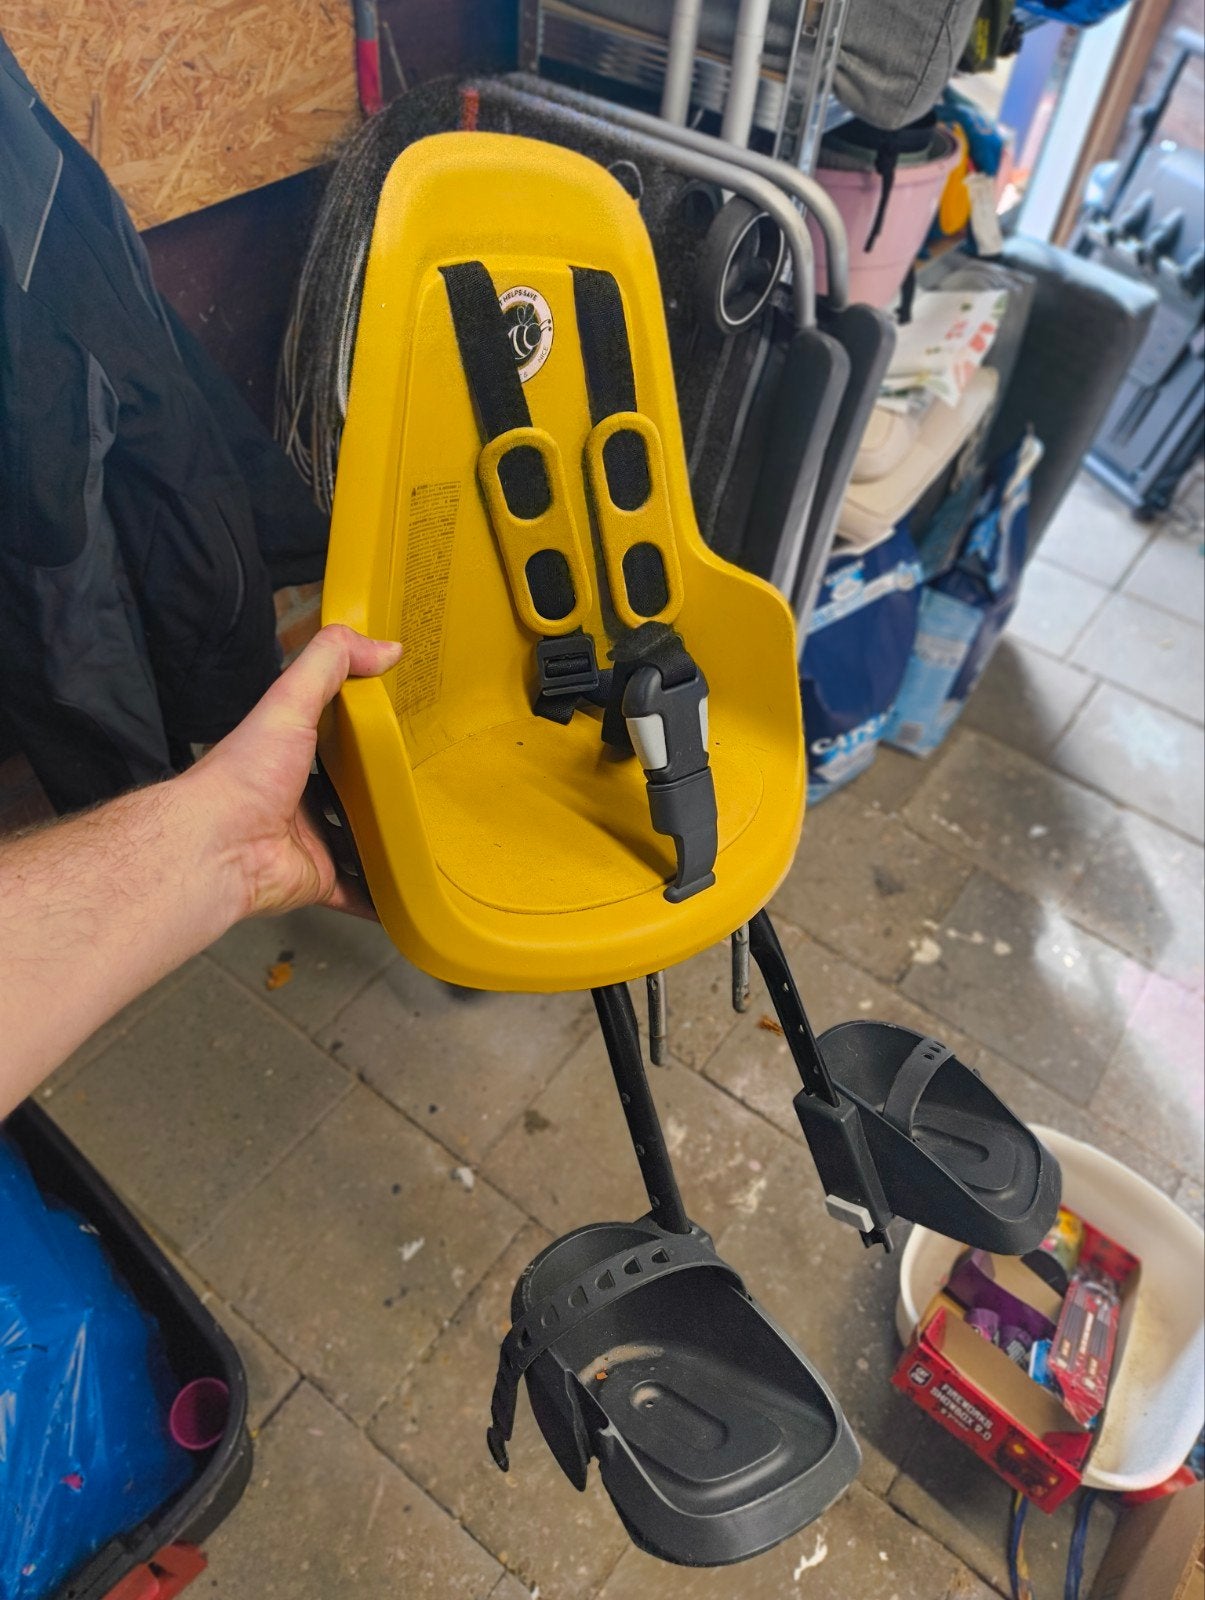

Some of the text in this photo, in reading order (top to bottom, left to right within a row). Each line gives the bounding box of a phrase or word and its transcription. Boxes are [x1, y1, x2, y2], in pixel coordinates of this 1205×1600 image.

[502, 289, 523, 303] HELPS
[522, 290, 538, 301] SAVE
[537, 346, 549, 363] NICE
[929, 1385, 974, 1427] SHOWBOX
[940, 1382, 994, 1430] FIREWORKS
